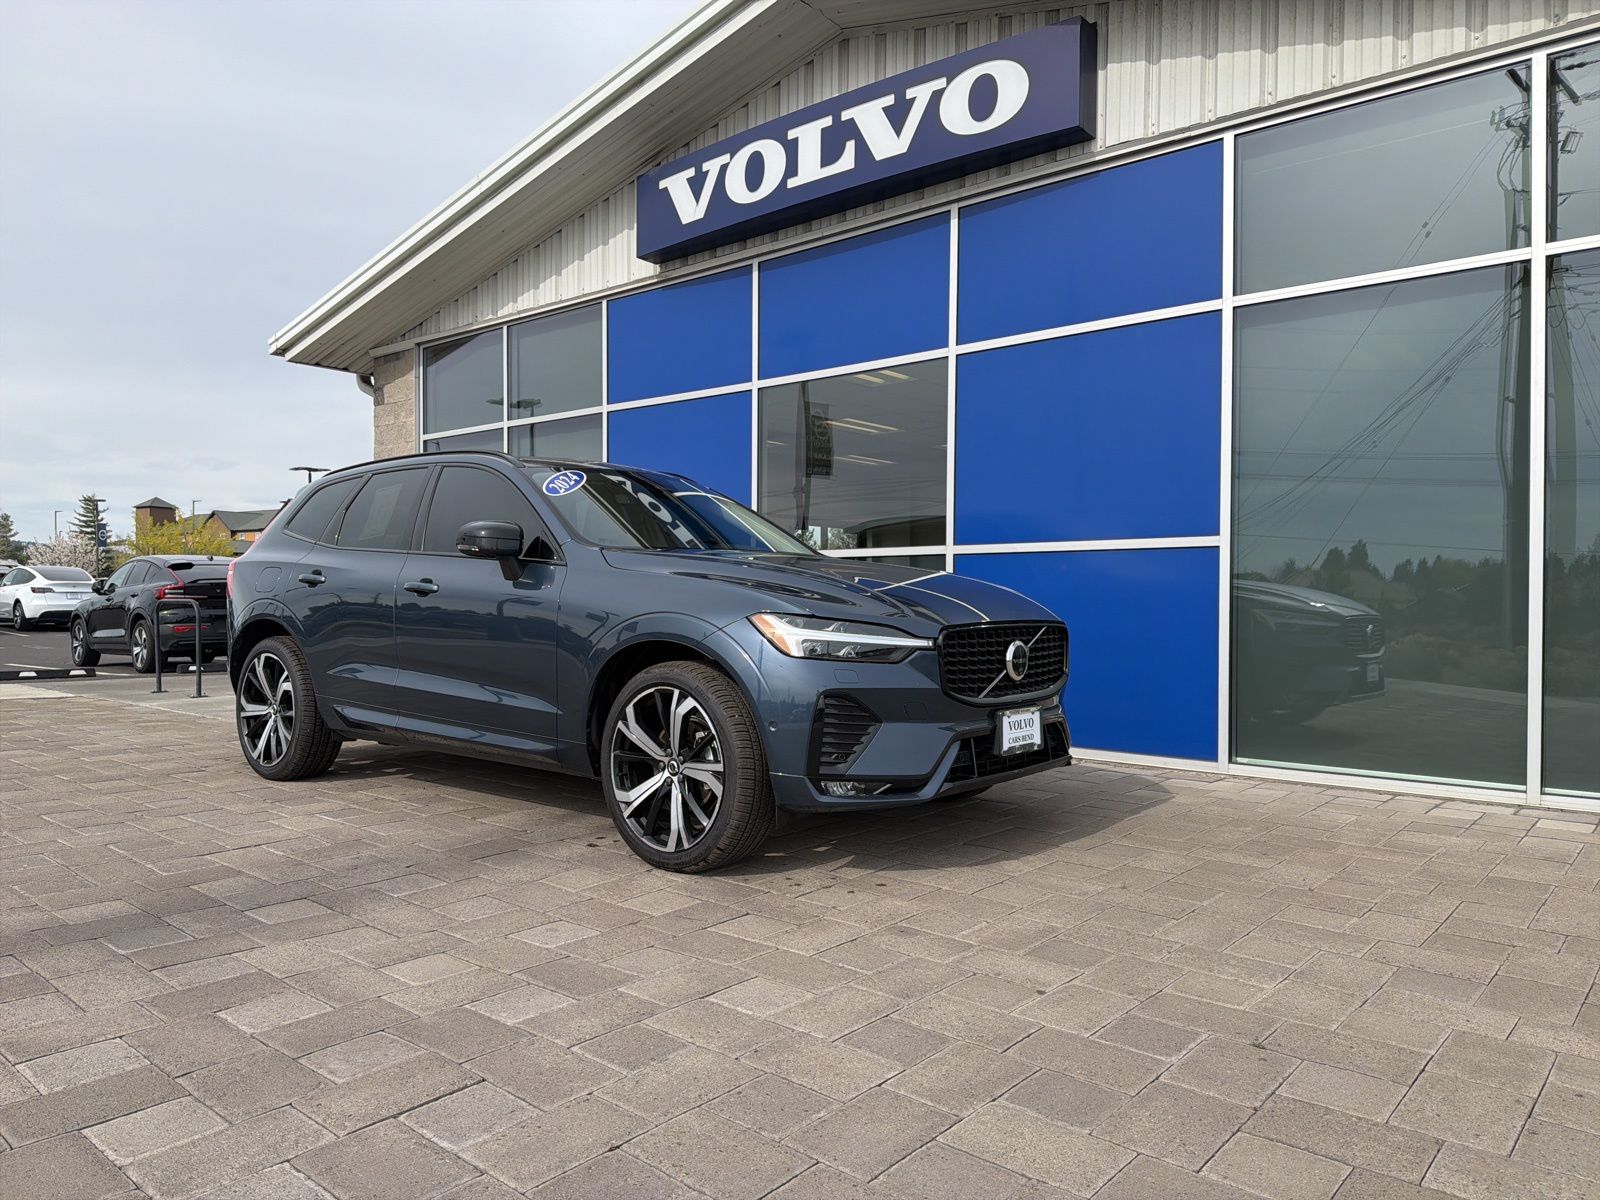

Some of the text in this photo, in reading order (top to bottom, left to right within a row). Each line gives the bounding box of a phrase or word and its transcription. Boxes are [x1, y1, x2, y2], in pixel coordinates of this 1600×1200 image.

[659, 59, 1030, 225] VOLVO
[549, 471, 580, 493] 2024
[1008, 718, 1034, 731] VOLVO
[1008, 733, 1035, 744] CARS BEND
